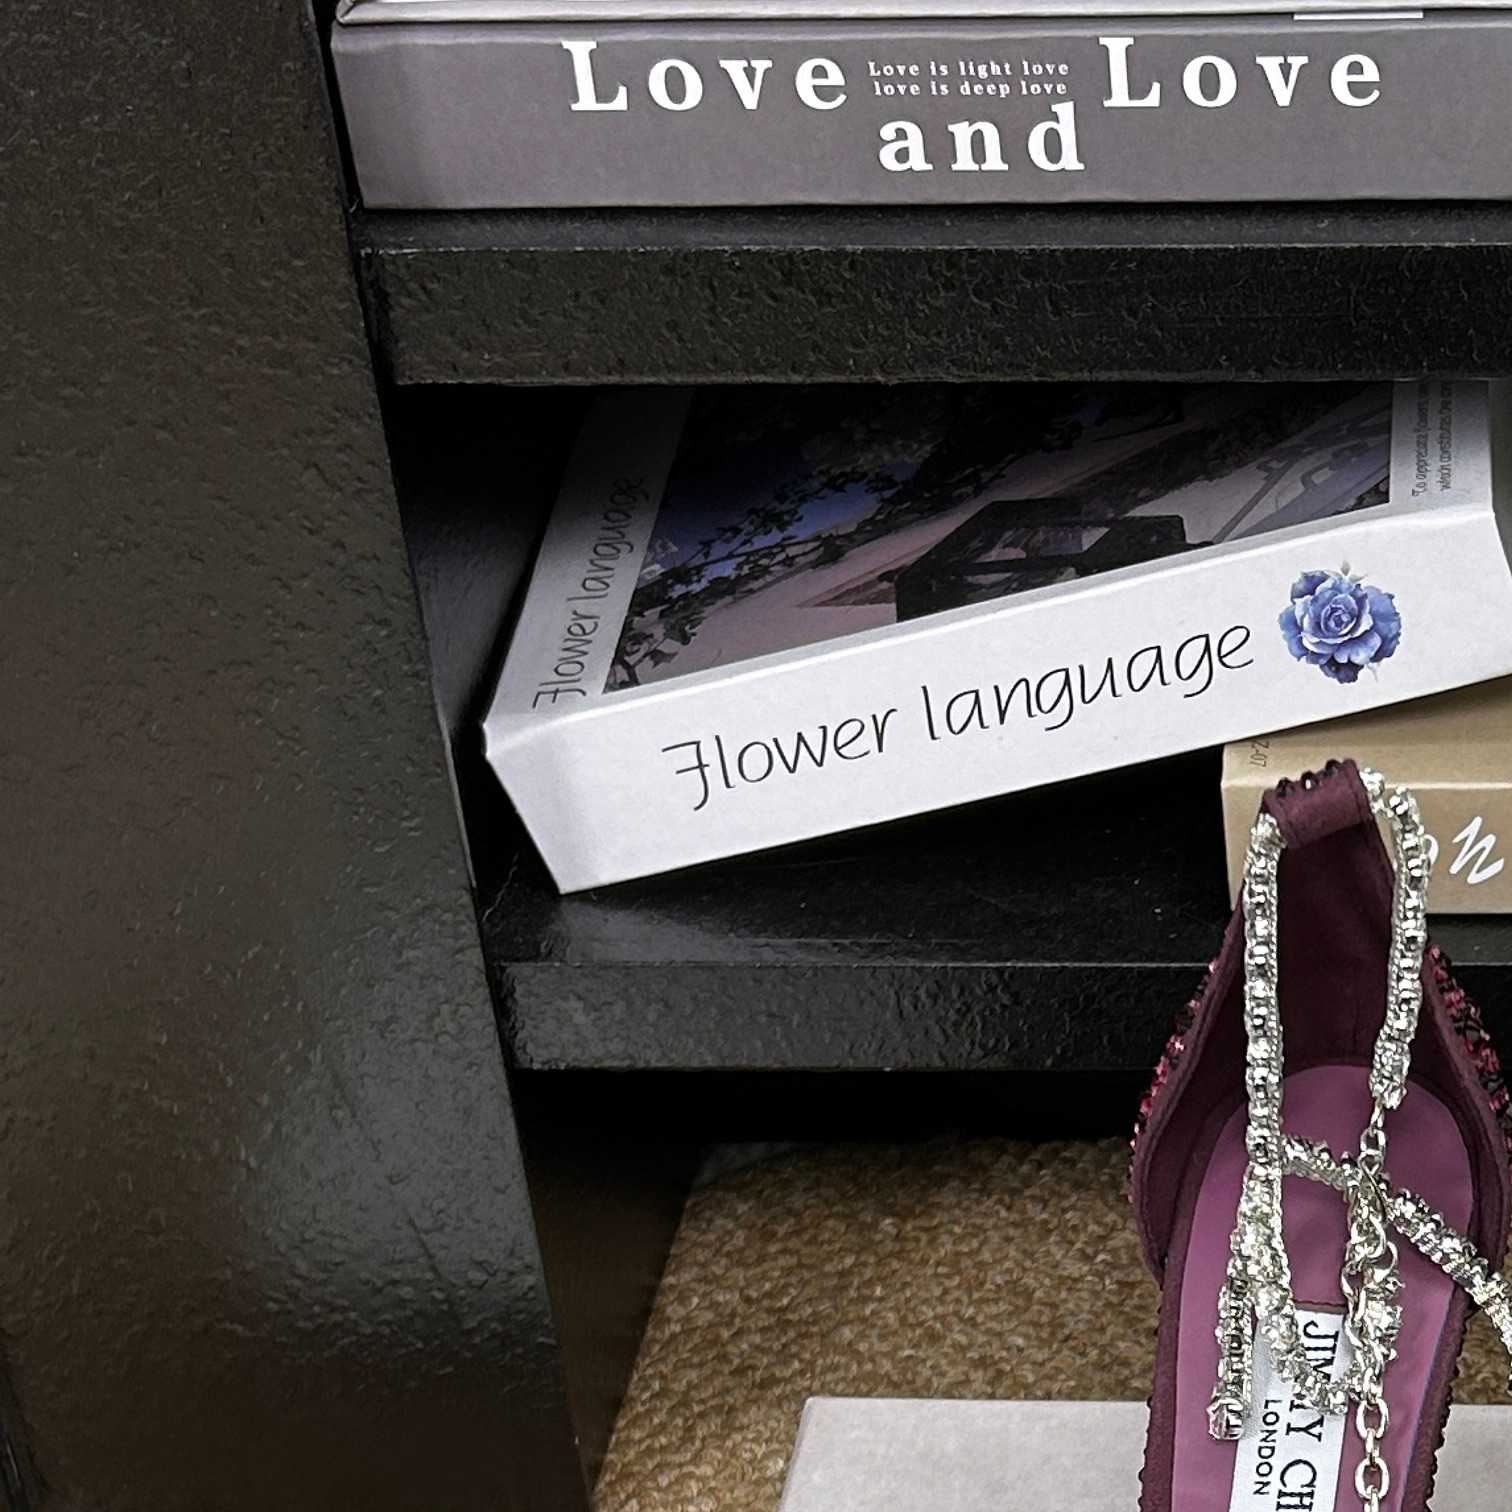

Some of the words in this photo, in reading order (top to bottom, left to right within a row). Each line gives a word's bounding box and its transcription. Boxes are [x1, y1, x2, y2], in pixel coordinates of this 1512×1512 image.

[561, 40, 848, 112] Love
[1098, 36, 1382, 108] Love
[867, 60, 920, 77] Love
[930, 60, 949, 77] is
[959, 59, 1013, 80] light
[1021, 59, 1070, 77] love
[874, 80, 921, 97] love
[930, 80, 950, 96] is
[959, 80, 1011, 98] deep
[1020, 79, 1068, 96] love
[879, 101, 1086, 172] and
[532, 610, 600, 709] Flower
[567, 477, 650, 602] language
[661, 706, 898, 812] Flower
[920, 624, 1255, 742] language
[1252, 1399, 1281, 1496] LONDON
